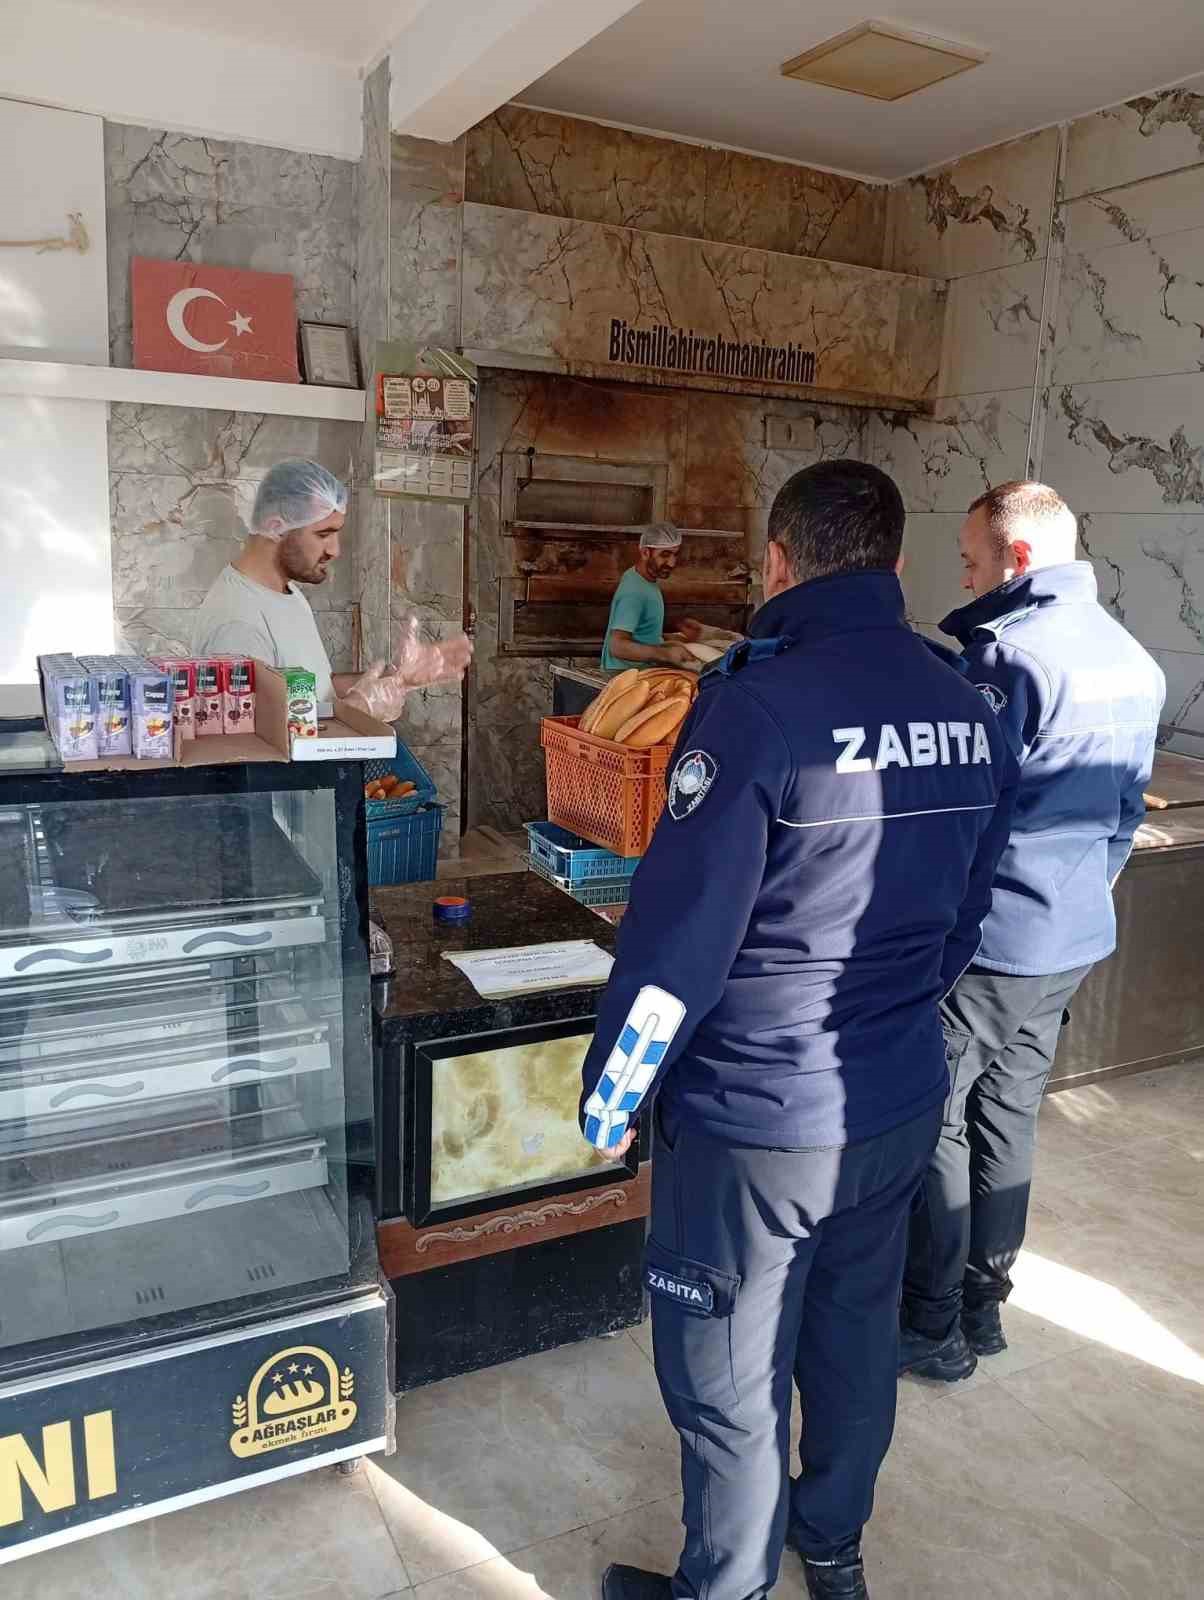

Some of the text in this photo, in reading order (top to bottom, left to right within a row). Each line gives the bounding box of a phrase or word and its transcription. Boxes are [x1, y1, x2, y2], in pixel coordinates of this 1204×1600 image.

[609, 319, 816, 383] Bismillahirrahmanirrahim
[832, 722, 992, 774] ZABITA
[648, 1271, 703, 1303] ZABITA
[261, 1434, 297, 1449] ekmek
